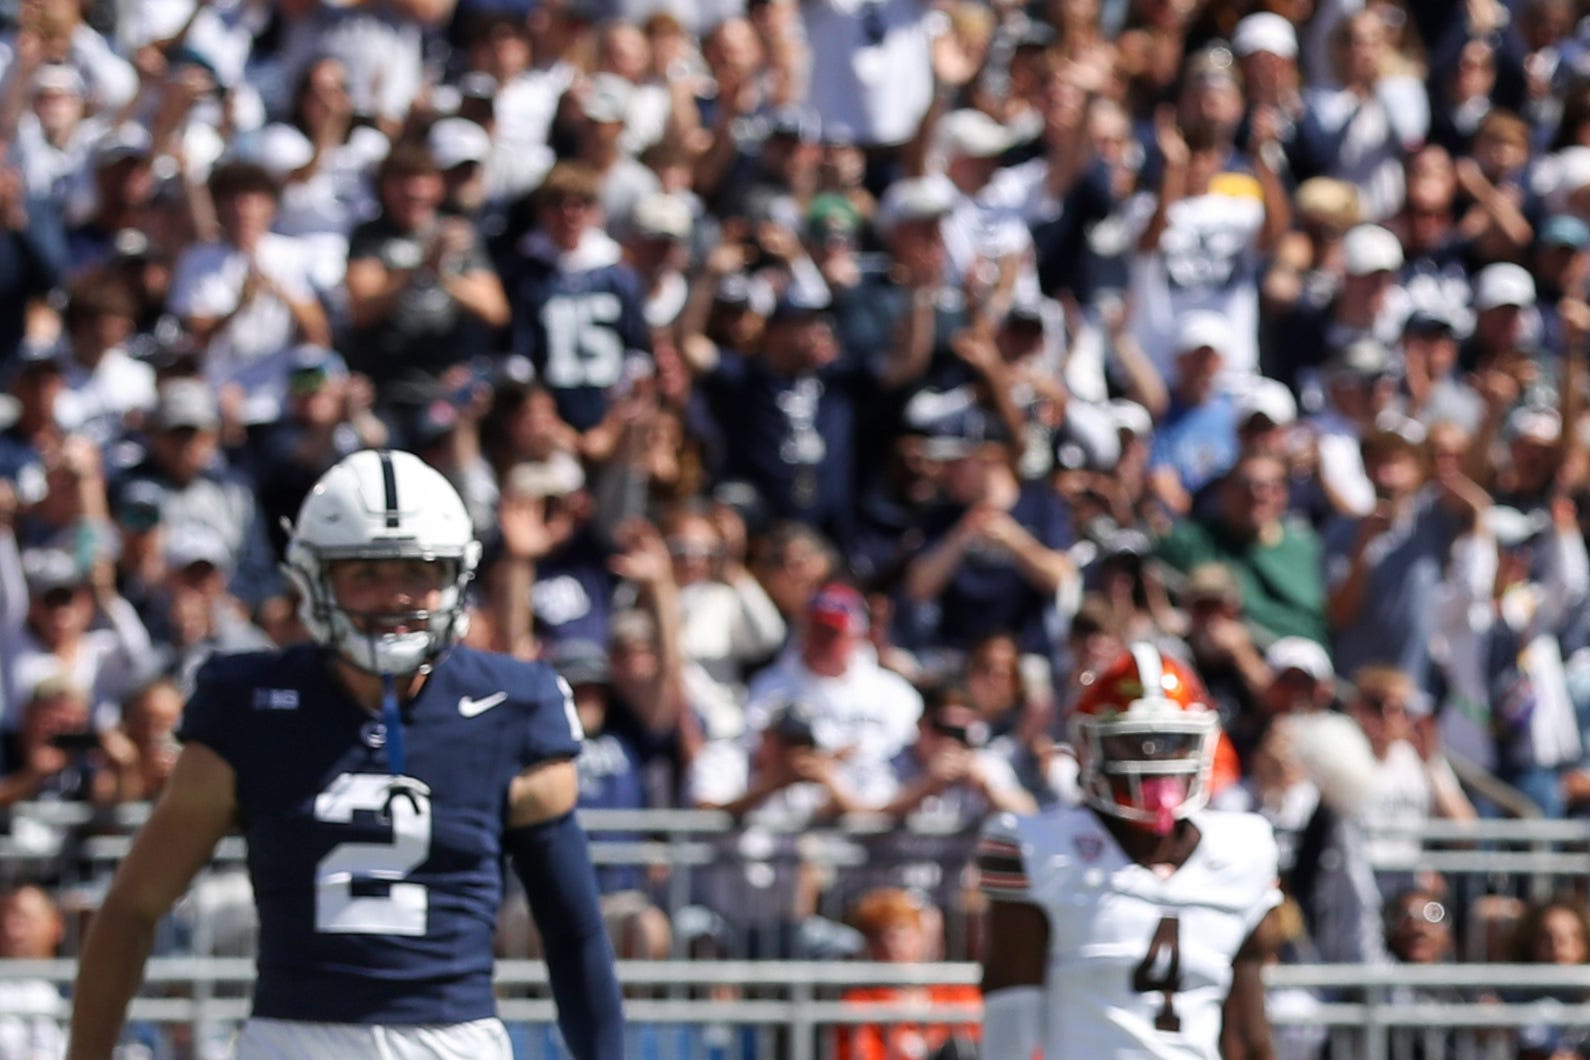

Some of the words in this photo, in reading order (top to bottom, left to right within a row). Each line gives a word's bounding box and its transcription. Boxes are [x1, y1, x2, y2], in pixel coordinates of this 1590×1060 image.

[541, 294, 623, 388] 15
[314, 772, 432, 936] 2
[1132, 917, 1181, 1031] 4
